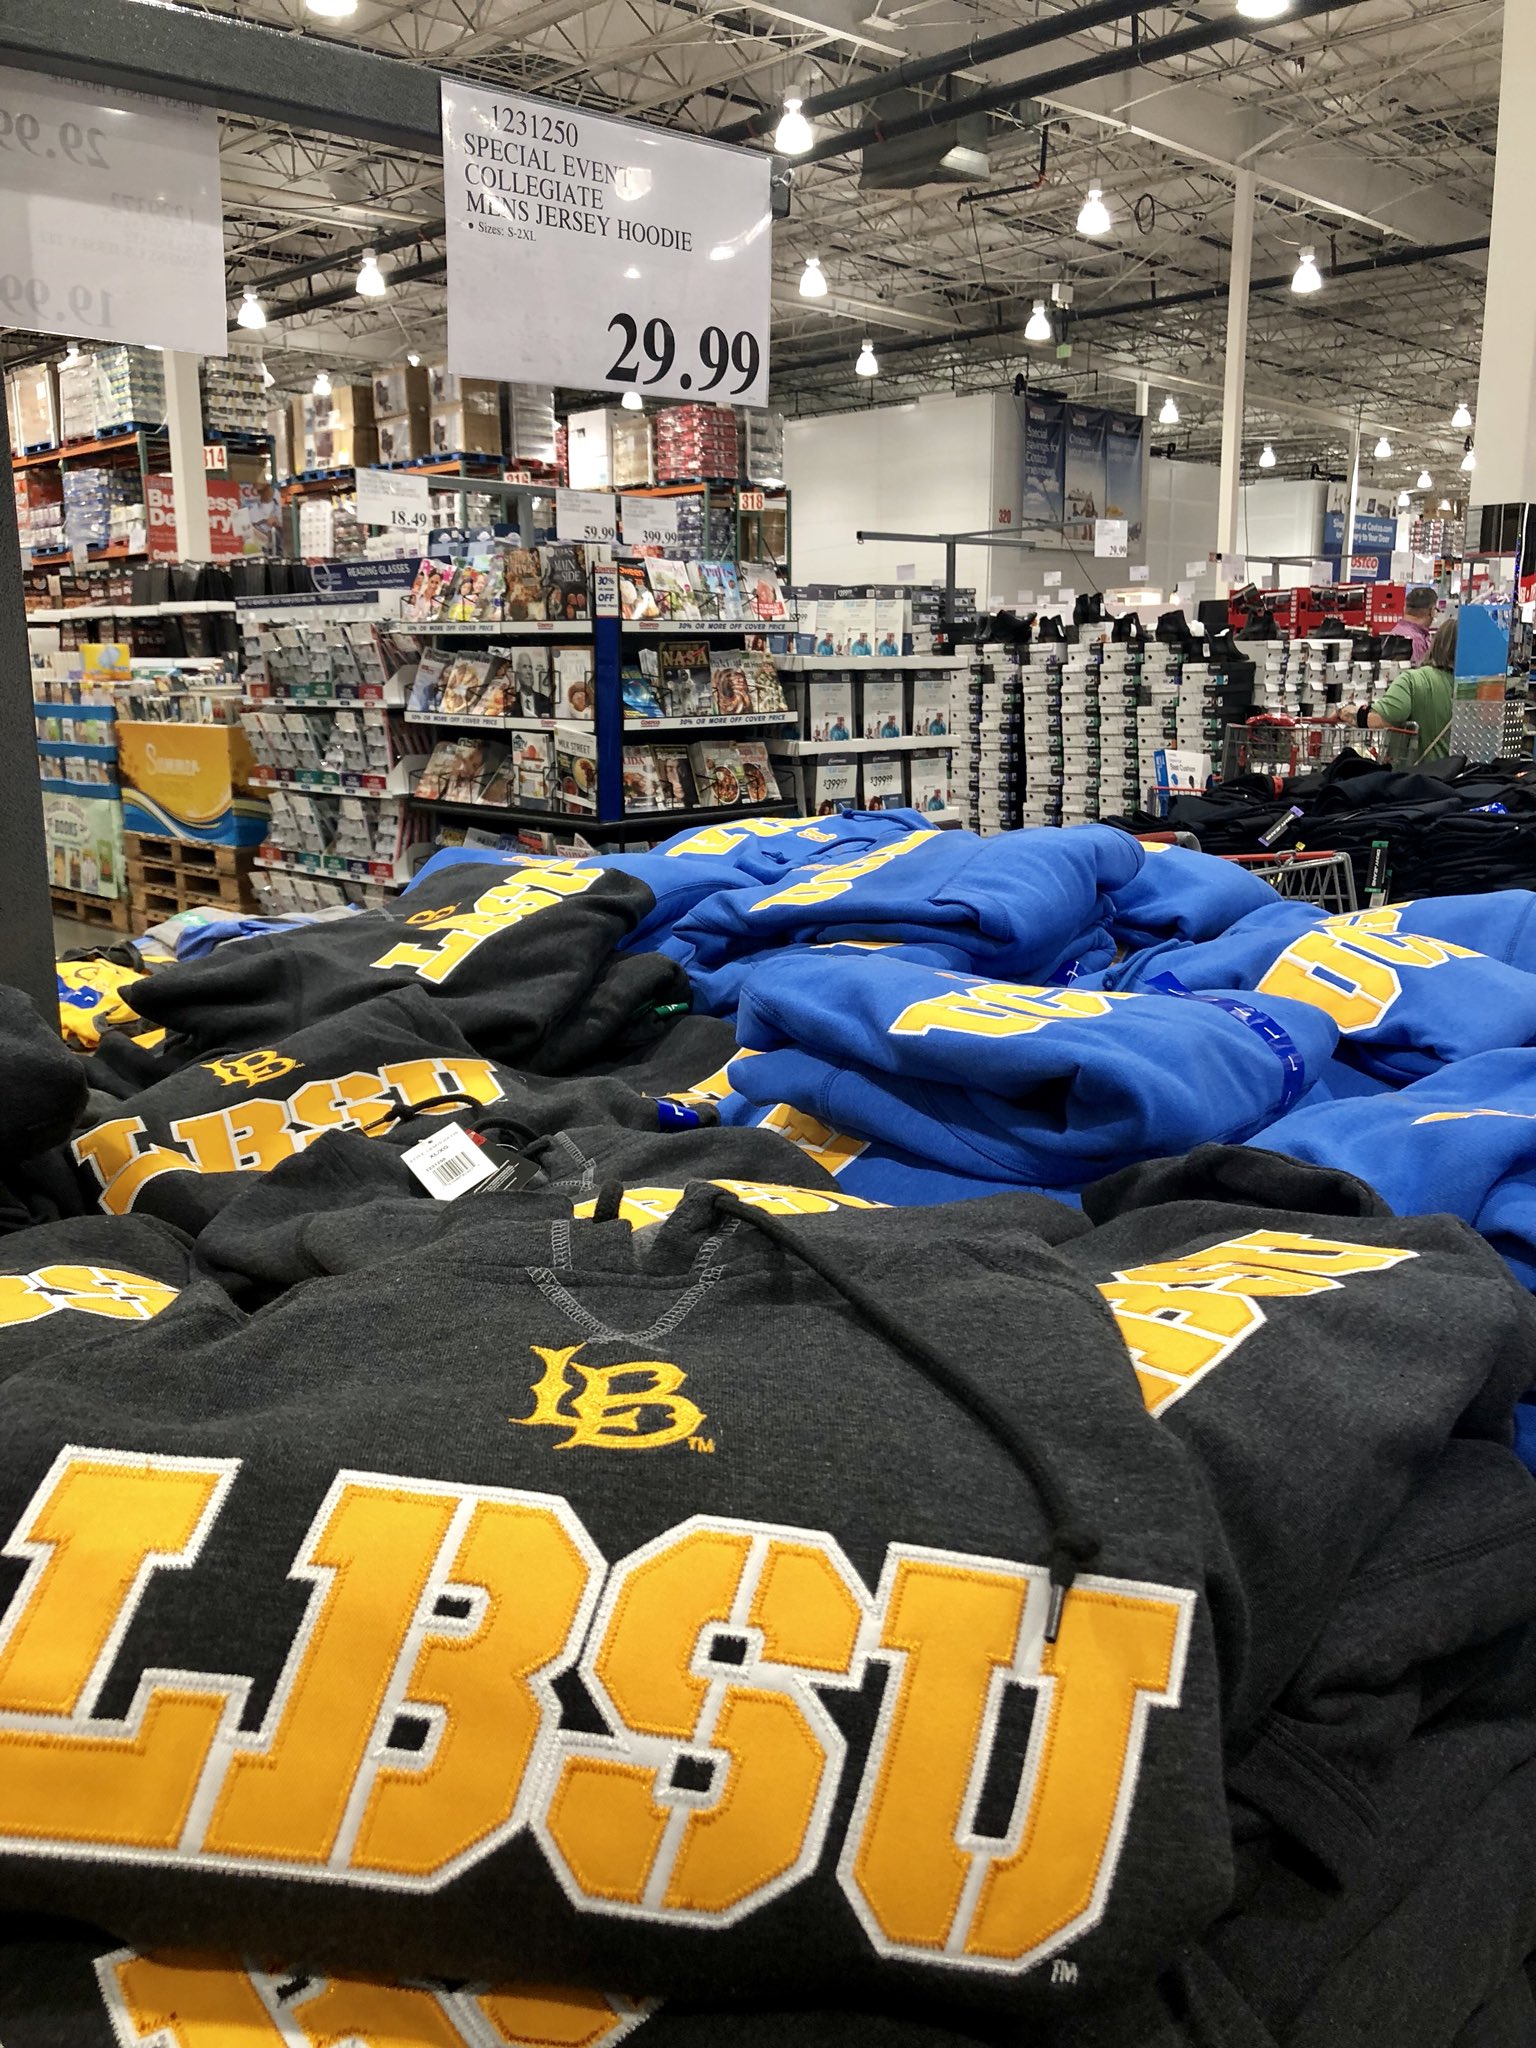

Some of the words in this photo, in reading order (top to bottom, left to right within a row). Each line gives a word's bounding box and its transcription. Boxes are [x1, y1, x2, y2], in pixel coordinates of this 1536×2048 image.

[491, 105, 578, 147] 1231250
[464, 133, 556, 173] SPECIAL
[563, 155, 632, 188] EVENT
[465, 162, 604, 210] COLLEGIATE
[478, 221, 504, 237] Sizes:
[507, 225, 537, 242] S-2XL
[536, 206, 610, 237] JERSEY
[618, 219, 693, 252] HOODIE
[605, 312, 760, 396] 29.99
[742, 494, 763, 510] 318
[391, 510, 427, 526] 18.49
[584, 526, 615, 540] 59.99
[643, 530, 677, 545] 399.99
[379, 563, 411, 576] GLASSES
[1350, 556, 1378, 570] OSTCO
[597, 593, 614, 602] OFF
[662, 650, 709, 667] NASA
[571, 741, 590, 754] STREET
[1372, 866, 1380, 886] JEANS
[71, 1058, 506, 1214] LBSU
[1095, 1229, 1420, 1418] BSU
[508, 1341, 708, 1449] LB
[688, 1437, 716, 1453] TM
[0, 1445, 1197, 1973] LBSU
